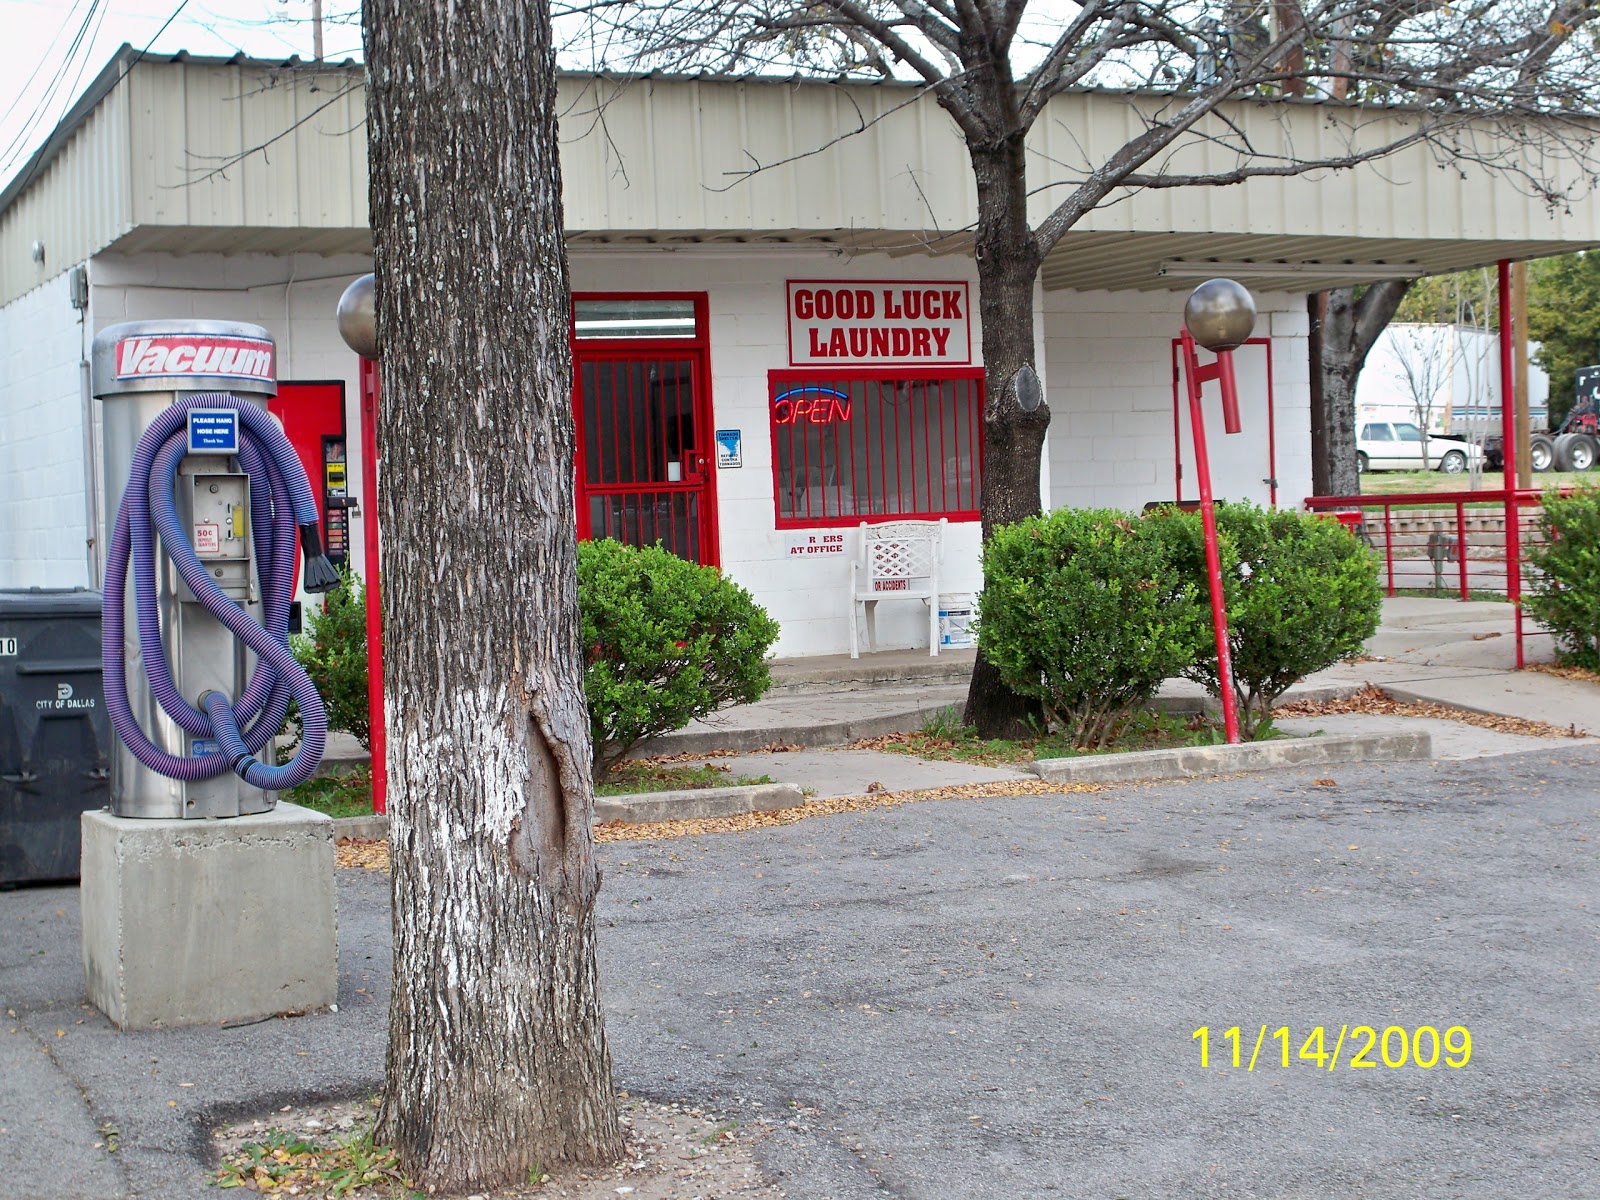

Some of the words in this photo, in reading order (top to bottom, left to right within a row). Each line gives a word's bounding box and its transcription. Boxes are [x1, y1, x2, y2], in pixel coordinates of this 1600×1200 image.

[794, 289, 875, 320] GOOD
[883, 290, 963, 320] LUCK
[808, 327, 951, 358] LAUNDRY
[120, 339, 271, 376] Vacuum
[774, 398, 851, 424] OPEN
[790, 546, 805, 554] AT
[807, 544, 843, 554] OFFICE
[35, 700, 52, 709] CITY
[55, 700, 65, 709] OF
[67, 699, 95, 709] DALLAS
